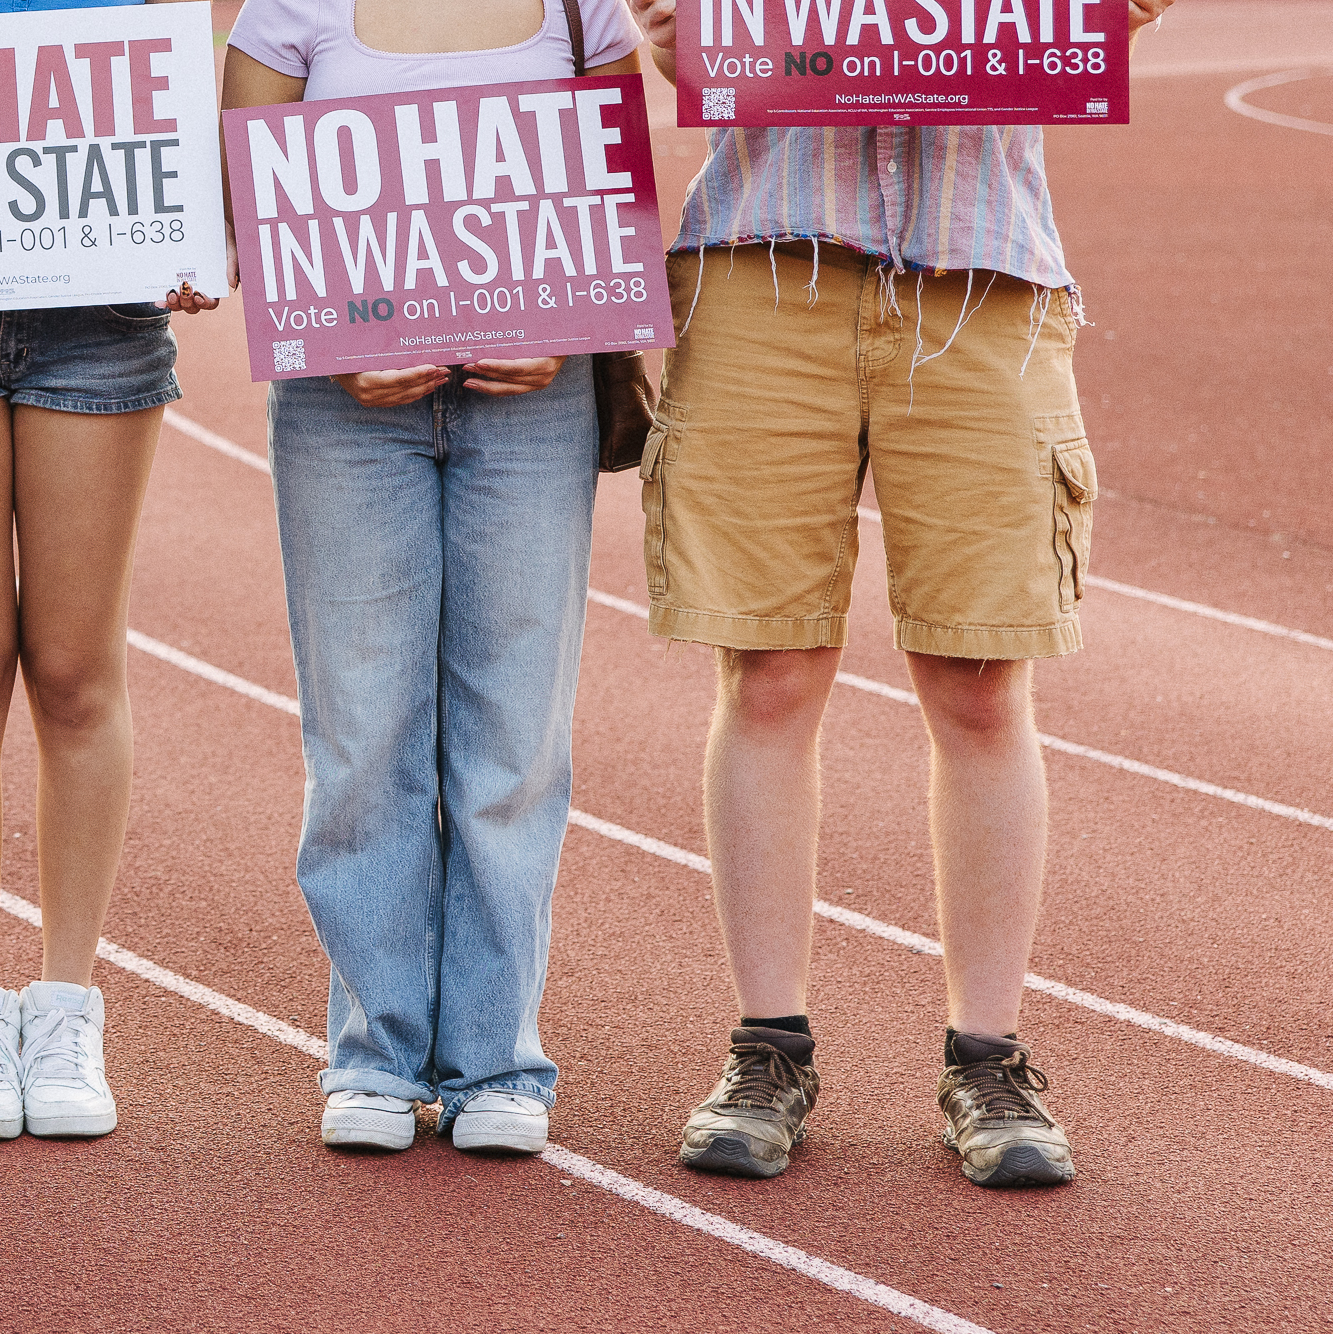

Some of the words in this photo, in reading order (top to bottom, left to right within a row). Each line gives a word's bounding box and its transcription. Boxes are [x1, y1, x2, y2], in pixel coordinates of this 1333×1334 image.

[702, 52, 773, 77] Vote
[784, 51, 833, 76] NO
[843, 55, 880, 76] on
[893, 49, 972, 76] I-001
[986, 48, 1006, 75] &
[1018, 48, 1105, 75] I-638
[835, 93, 968, 106] NoHateInWAState.org
[247, 110, 381, 219] NO
[394, 88, 632, 205] HATE
[6, 139, 184, 222] STATE
[0, 227, 67, 252] I-001
[80, 225, 97, 248] &
[109, 219, 184, 246] I-638
[258, 219, 326, 303] IN
[332, 210, 449, 294] WA
[452, 193, 643, 284] STATE
[268, 304, 337, 332] Vote
[347, 298, 394, 323] NO
[404, 298, 439, 319] on
[450, 286, 525, 315] I-001
[538, 284, 557, 308] &
[567, 278, 647, 306] I-638
[399, 327, 526, 347] NoHateInWAState.org
[56, 994, 84, 1005] Reebo
